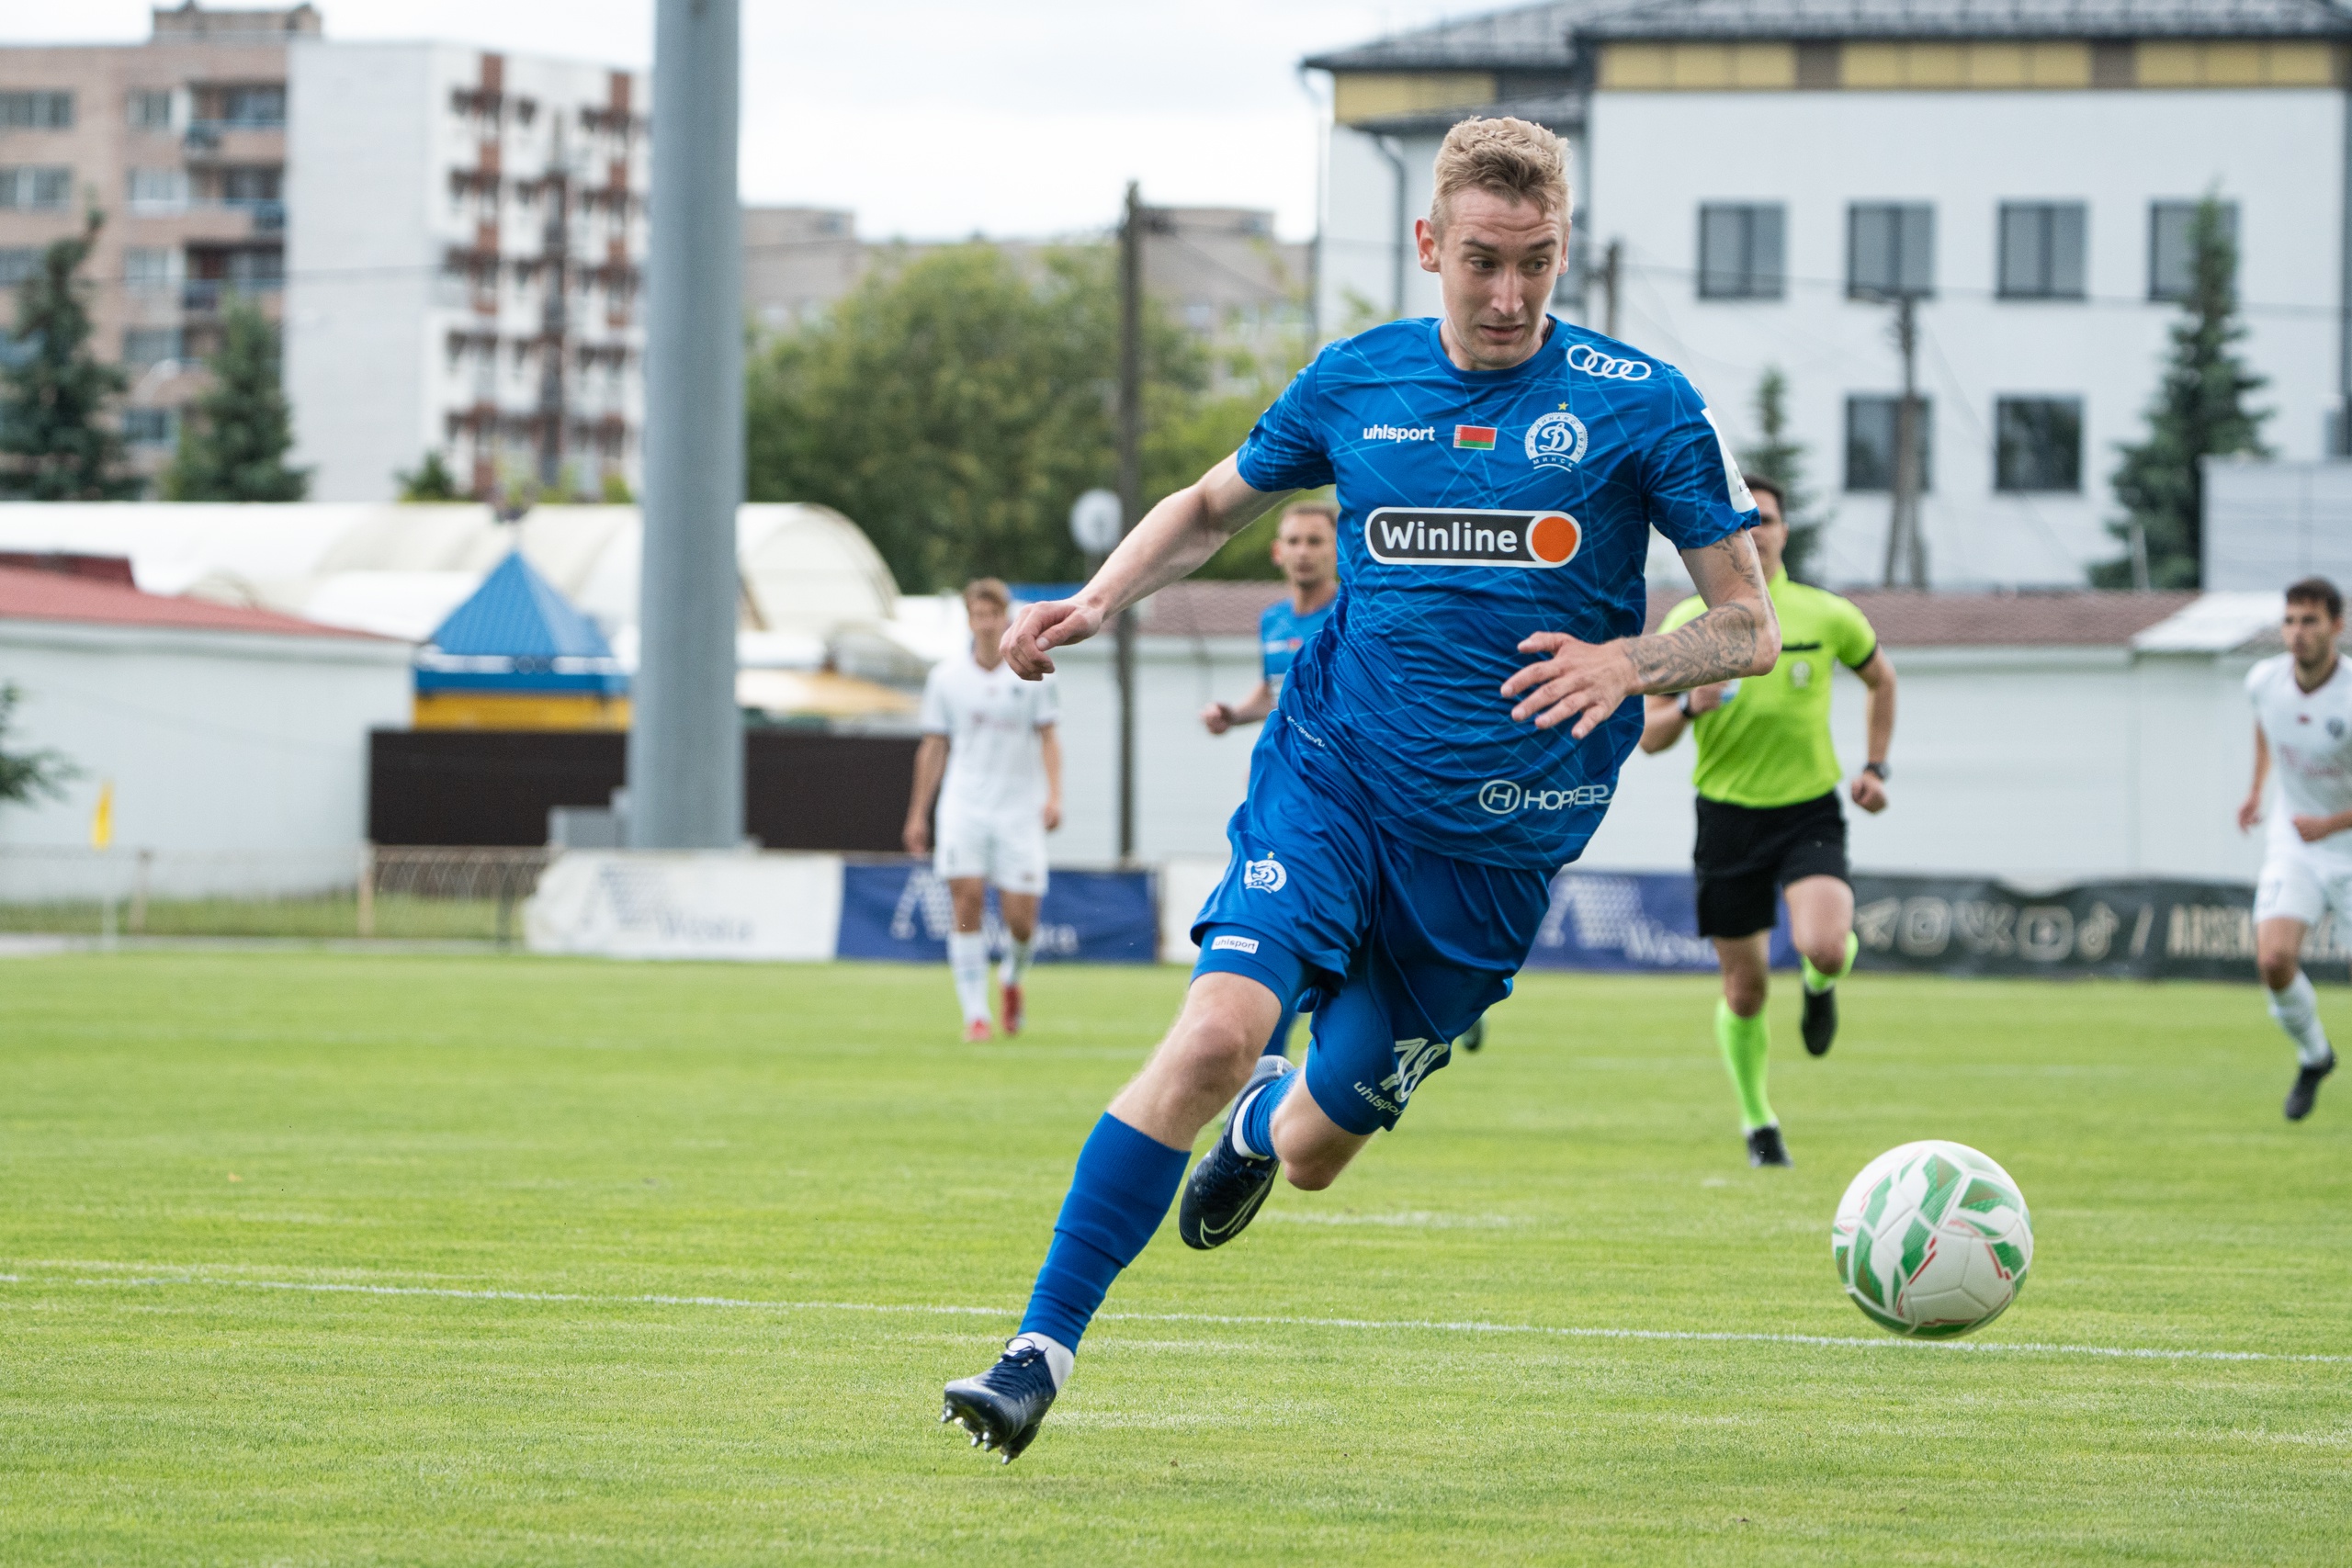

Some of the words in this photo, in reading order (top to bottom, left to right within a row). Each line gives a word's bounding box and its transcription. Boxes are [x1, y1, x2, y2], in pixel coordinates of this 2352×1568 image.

[1363, 423, 1435, 444] uhlsport
[1532, 457, 1574, 468] МИНСК
[1380, 520, 1518, 553] Winline
[1215, 938, 1256, 950] uhlsport
[1353, 1081, 1406, 1115] uhlspor
